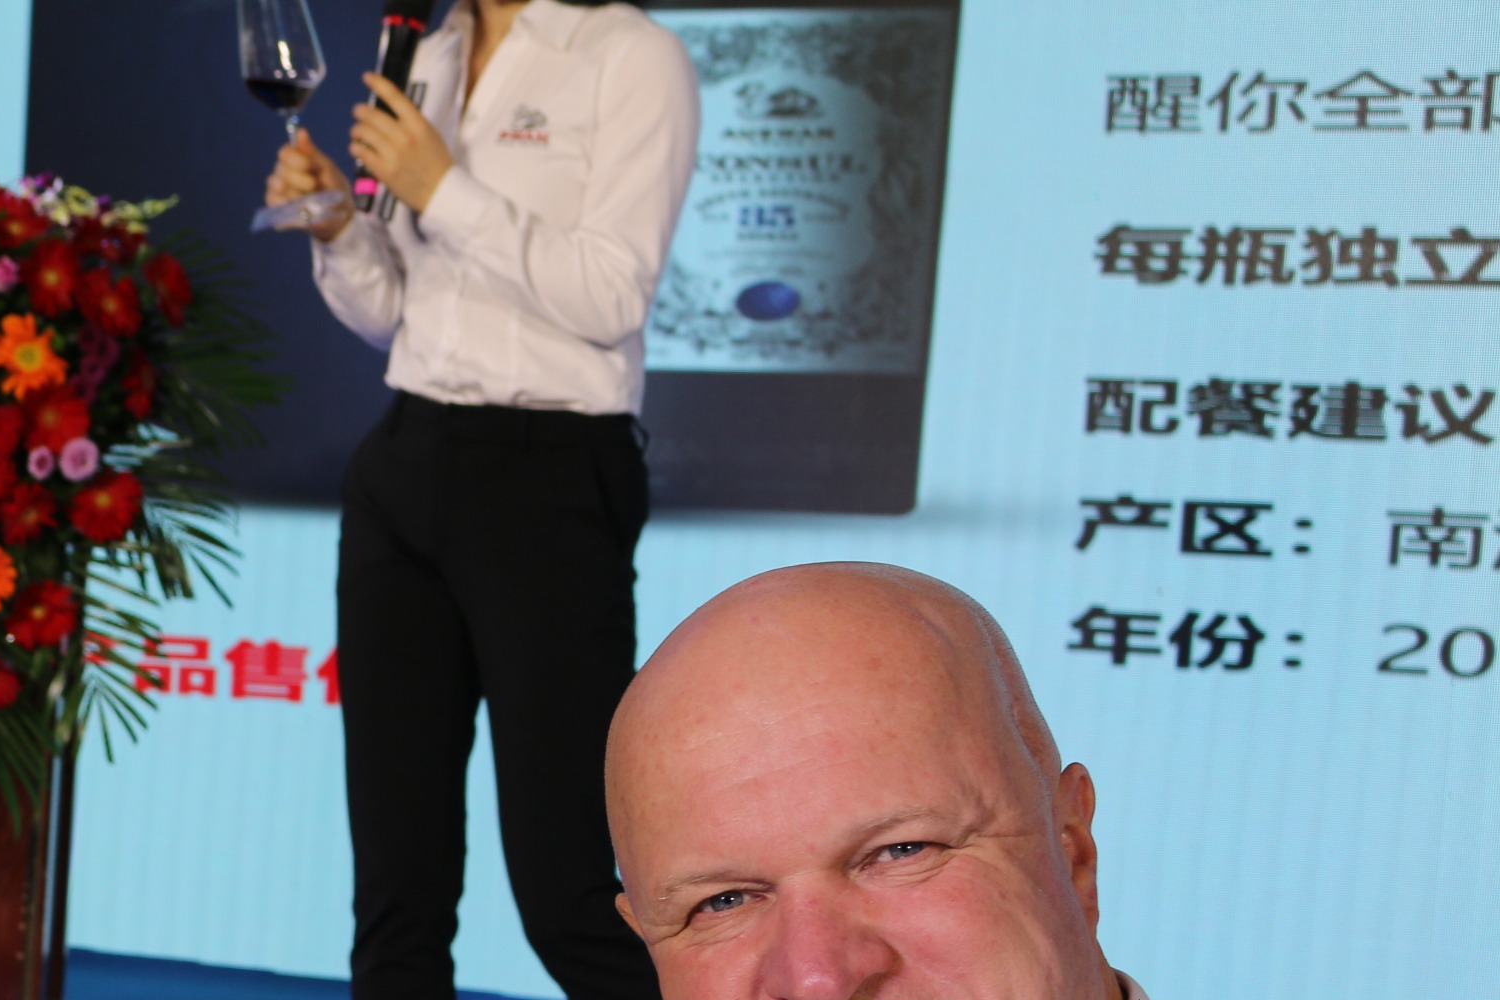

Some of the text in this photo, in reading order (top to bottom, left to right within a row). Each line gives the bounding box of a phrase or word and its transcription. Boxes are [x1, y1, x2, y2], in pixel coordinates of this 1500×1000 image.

[1094, 223, 1500, 288] 每瓶独立
[1084, 376, 1495, 445] 配餐建议
[1386, 505, 1500, 571] 南
[1377, 622, 1495, 679] 20
